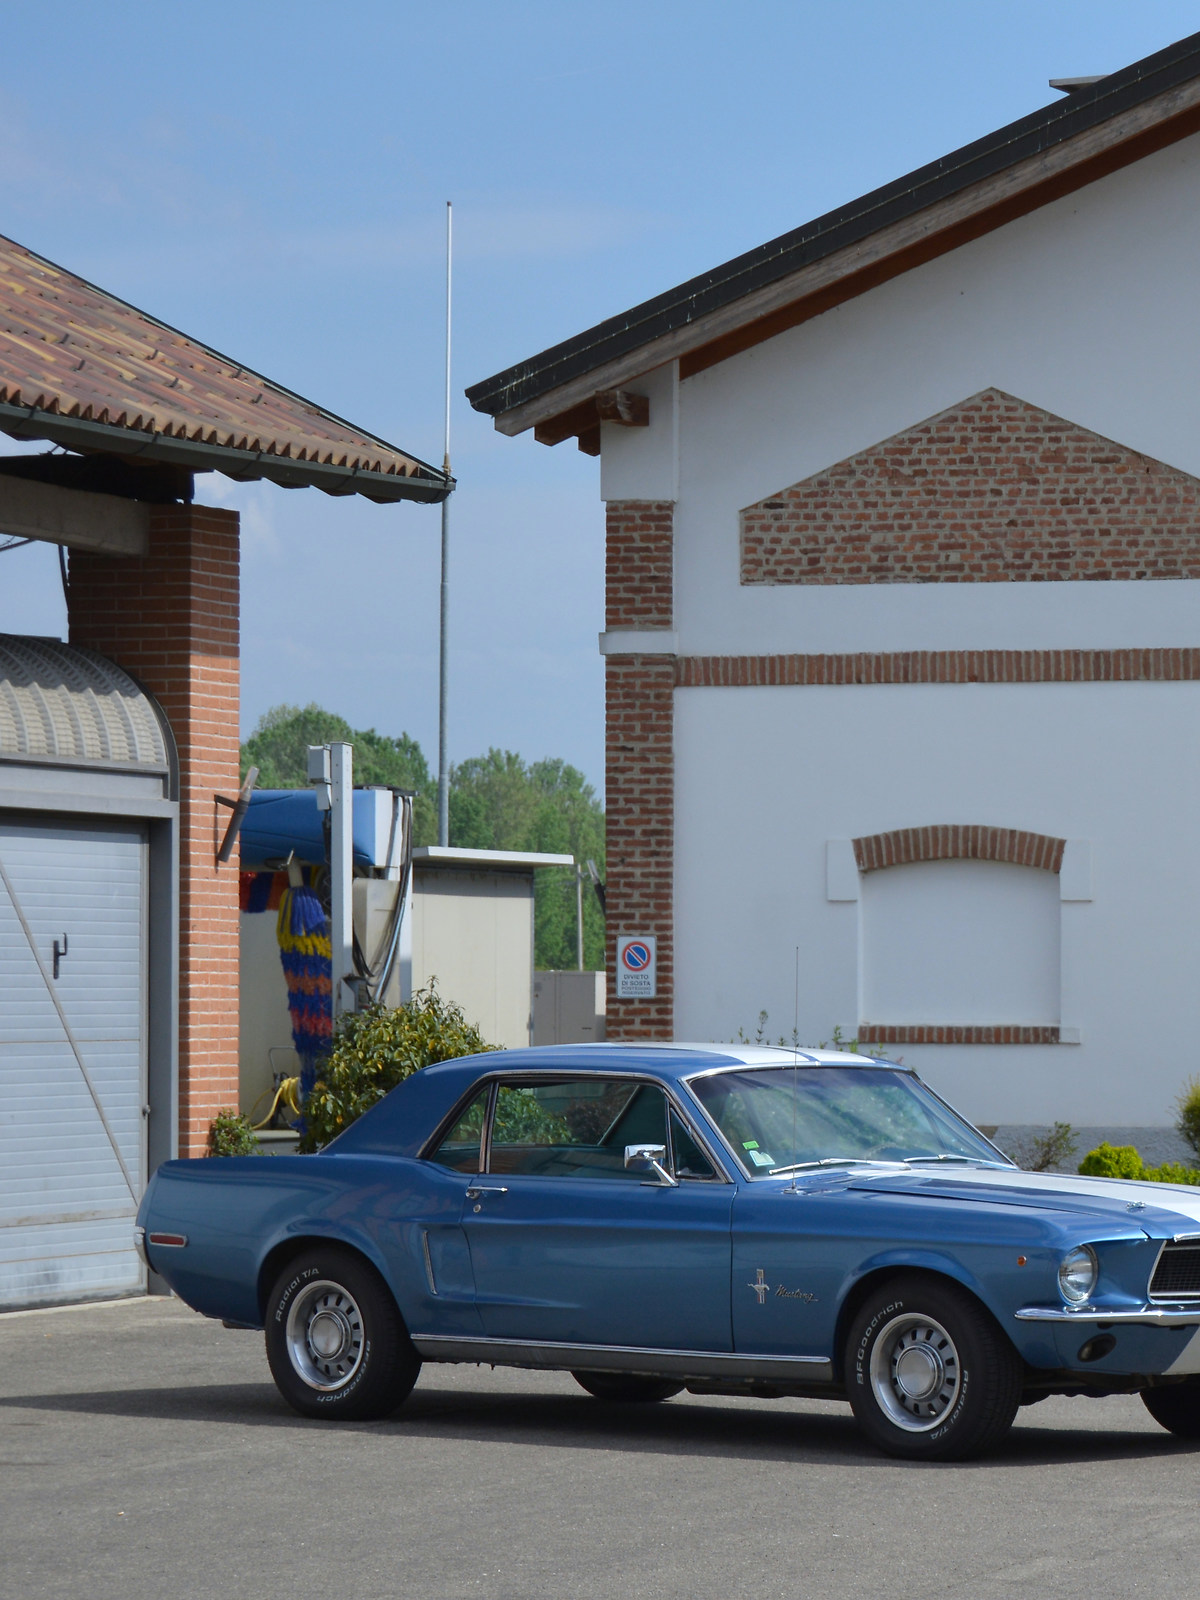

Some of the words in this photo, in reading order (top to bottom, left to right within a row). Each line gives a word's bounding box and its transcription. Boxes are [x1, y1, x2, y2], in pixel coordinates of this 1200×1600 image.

[275, 1276, 300, 1322] Radial
[301, 1267, 320, 1279] T/A
[774, 1284, 819, 1304] Mustang
[856, 1300, 904, 1385] BFGoodrich
